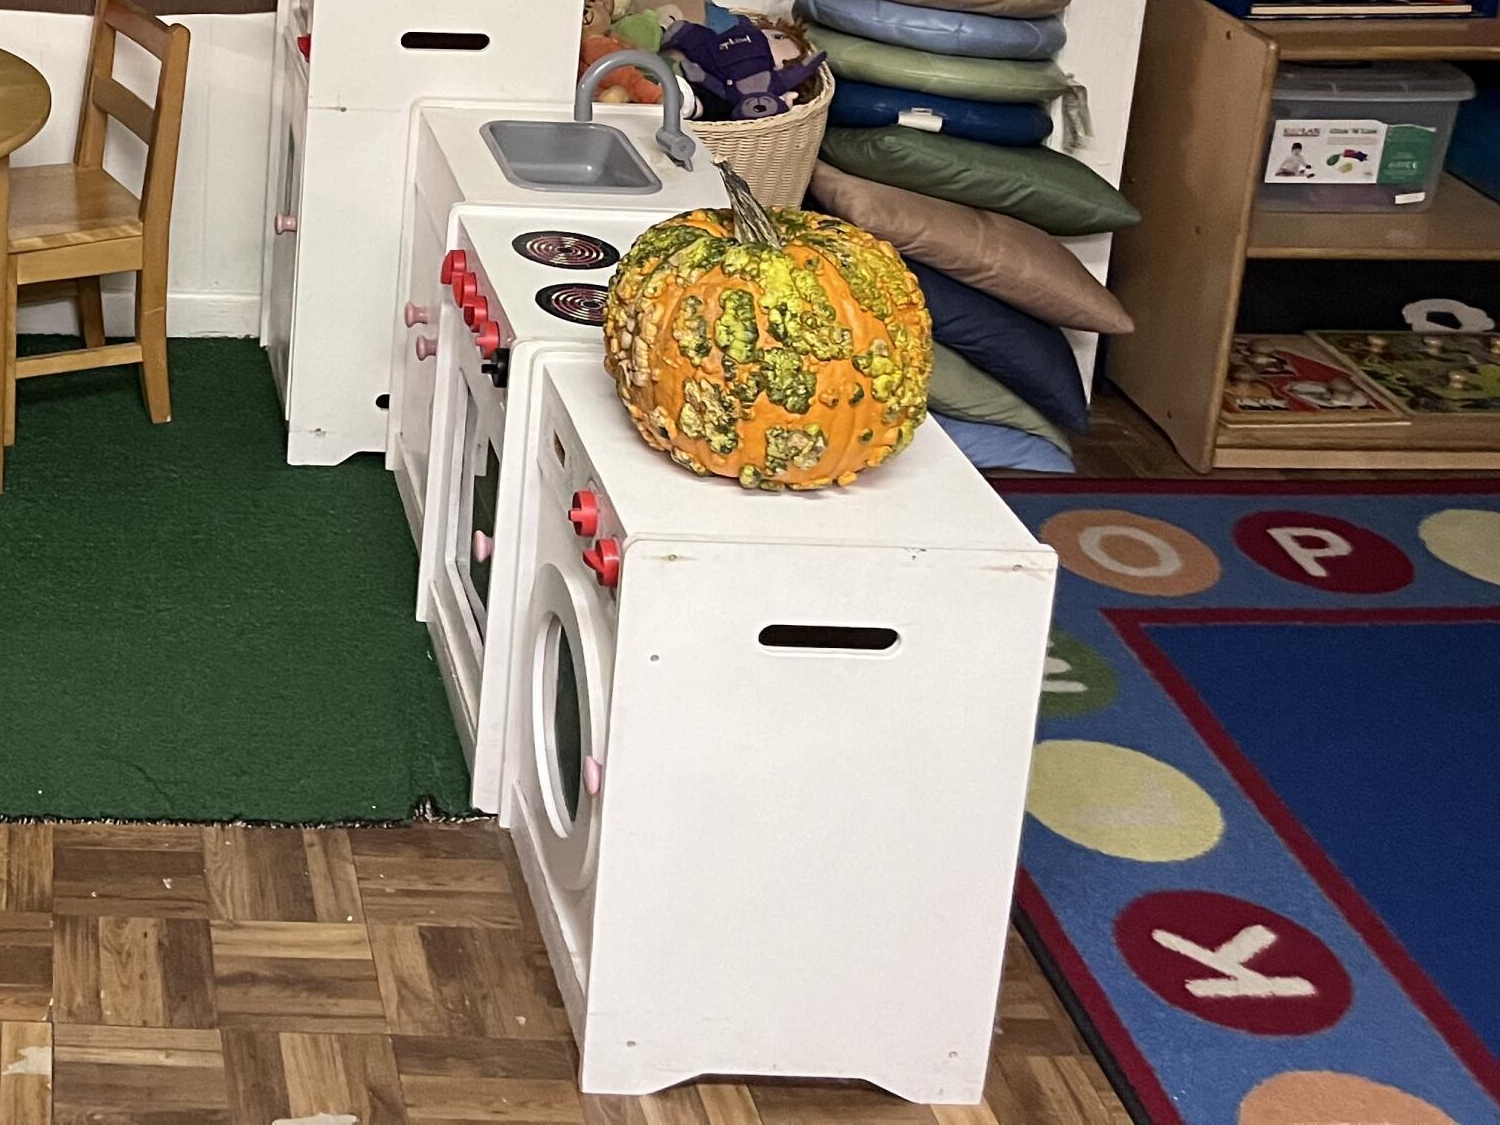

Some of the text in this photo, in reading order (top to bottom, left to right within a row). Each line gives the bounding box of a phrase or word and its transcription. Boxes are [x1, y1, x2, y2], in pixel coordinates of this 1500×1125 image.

[1079, 525, 1182, 576] O
[1267, 526, 1352, 577] P
[1152, 923, 1317, 998] K
